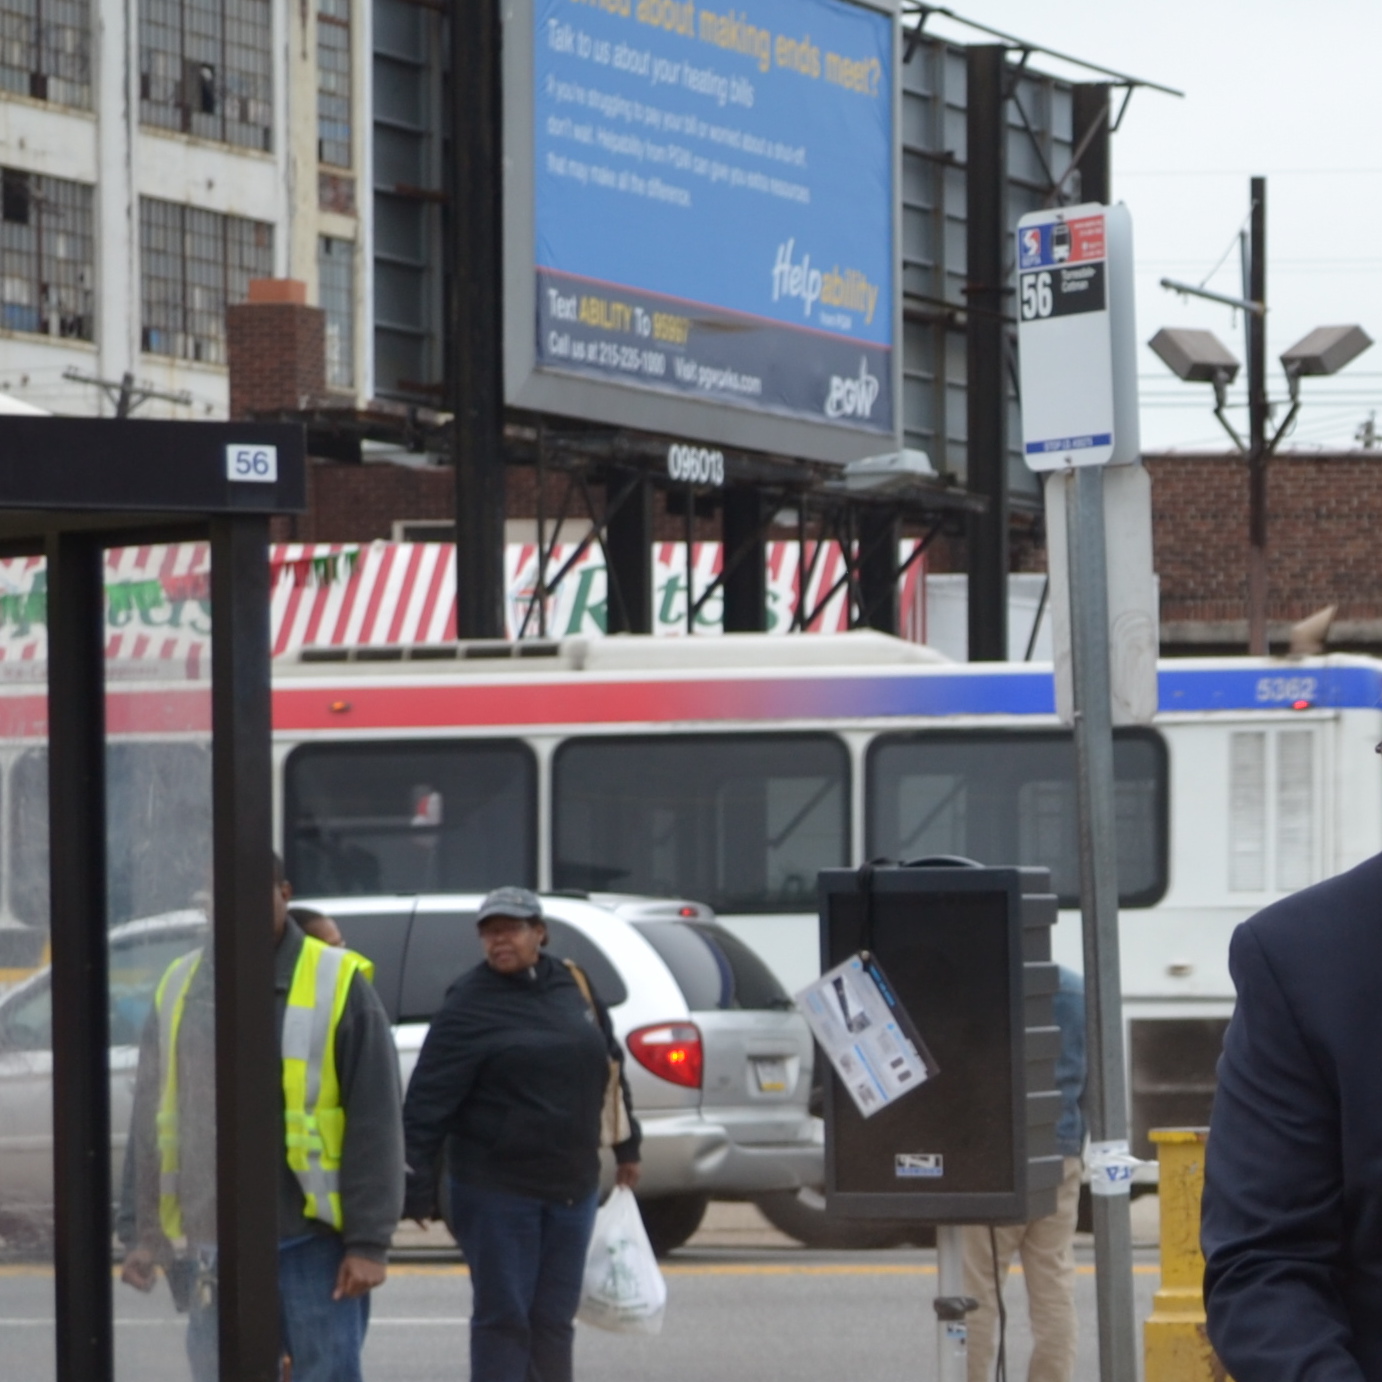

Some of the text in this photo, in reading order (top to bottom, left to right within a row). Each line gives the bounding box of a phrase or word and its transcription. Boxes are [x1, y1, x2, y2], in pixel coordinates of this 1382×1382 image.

[548, 18, 575, 53] Talk
[578, 30, 592, 59] to
[593, 40, 611, 63] us
[613, 41, 650, 76] about
[652, 57, 682, 87] your
[700, 9, 770, 73] making
[776, 33, 821, 78] ends
[825, 53, 881, 97] meet?
[772, 236, 880, 326] Helpability
[1021, 271, 1053, 319] 56
[547, 288, 578, 322] Text
[579, 294, 633, 332] ABILITY
[633, 306, 651, 337] To
[549, 330, 571, 356] Call
[572, 340, 585, 360] us
[824, 355, 879, 418] PGW
[236, 450, 270, 475] 56
